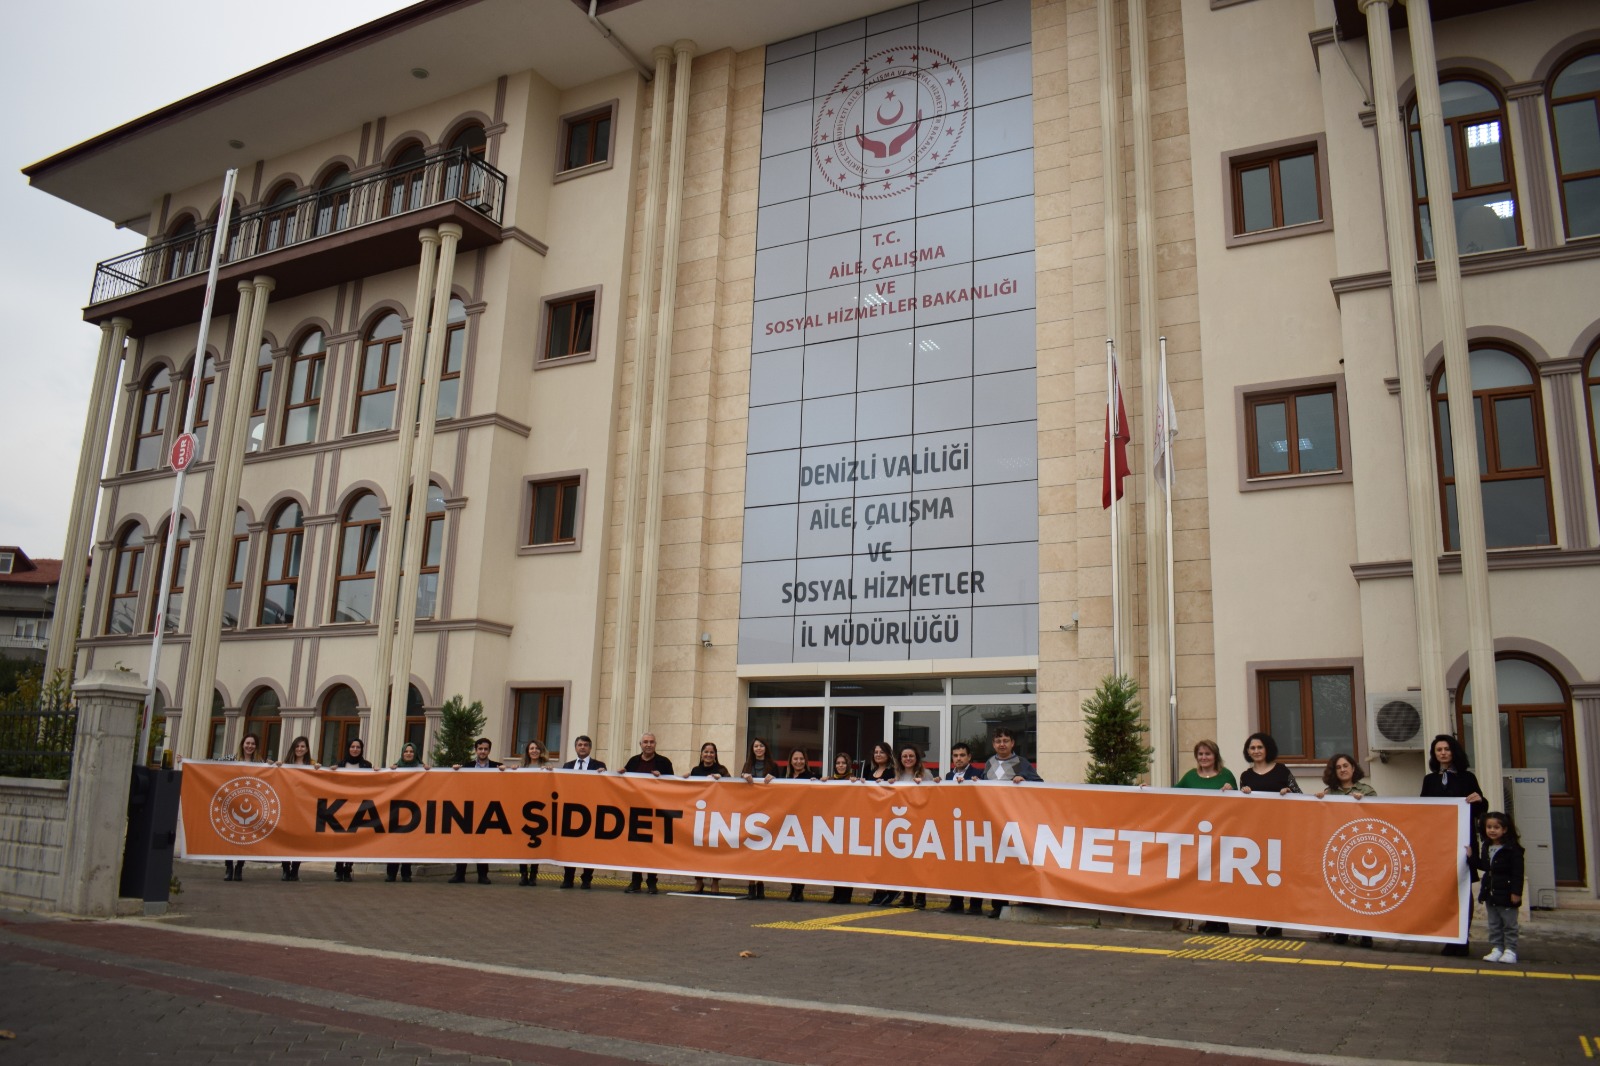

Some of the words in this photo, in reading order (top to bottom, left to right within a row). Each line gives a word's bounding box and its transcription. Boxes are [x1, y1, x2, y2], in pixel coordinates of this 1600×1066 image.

[930, 84, 943, 123] HİZMETLR
[872, 231, 901, 247] T.C.
[829, 261, 868, 280] AİLE,
[871, 245, 946, 274] ÇALIŞMA
[875, 281, 896, 296] VE
[765, 314, 823, 336] SOSYAL
[827, 297, 918, 325] HİZMETLER
[922, 279, 1018, 309] BAKANLIĞI
[178, 439, 187, 465] DUR
[800, 453, 877, 487] DENİZLİ
[883, 443, 970, 479] VALİLİĞİ
[809, 503, 858, 531] AİLE,
[864, 496, 955, 531] ÇALIŞMA
[868, 541, 892, 563] VE
[781, 578, 858, 604] SOSYAL
[864, 570, 986, 600] HİZMETLER
[801, 620, 818, 648] İL
[823, 614, 960, 647] MÜDÜRLÜĞÜ
[315, 798, 511, 835] KADINA
[520, 791, 684, 849] ŞİDDET
[692, 800, 945, 860] İNSANLIĞA
[953, 807, 1283, 888] İHANETTİR!
